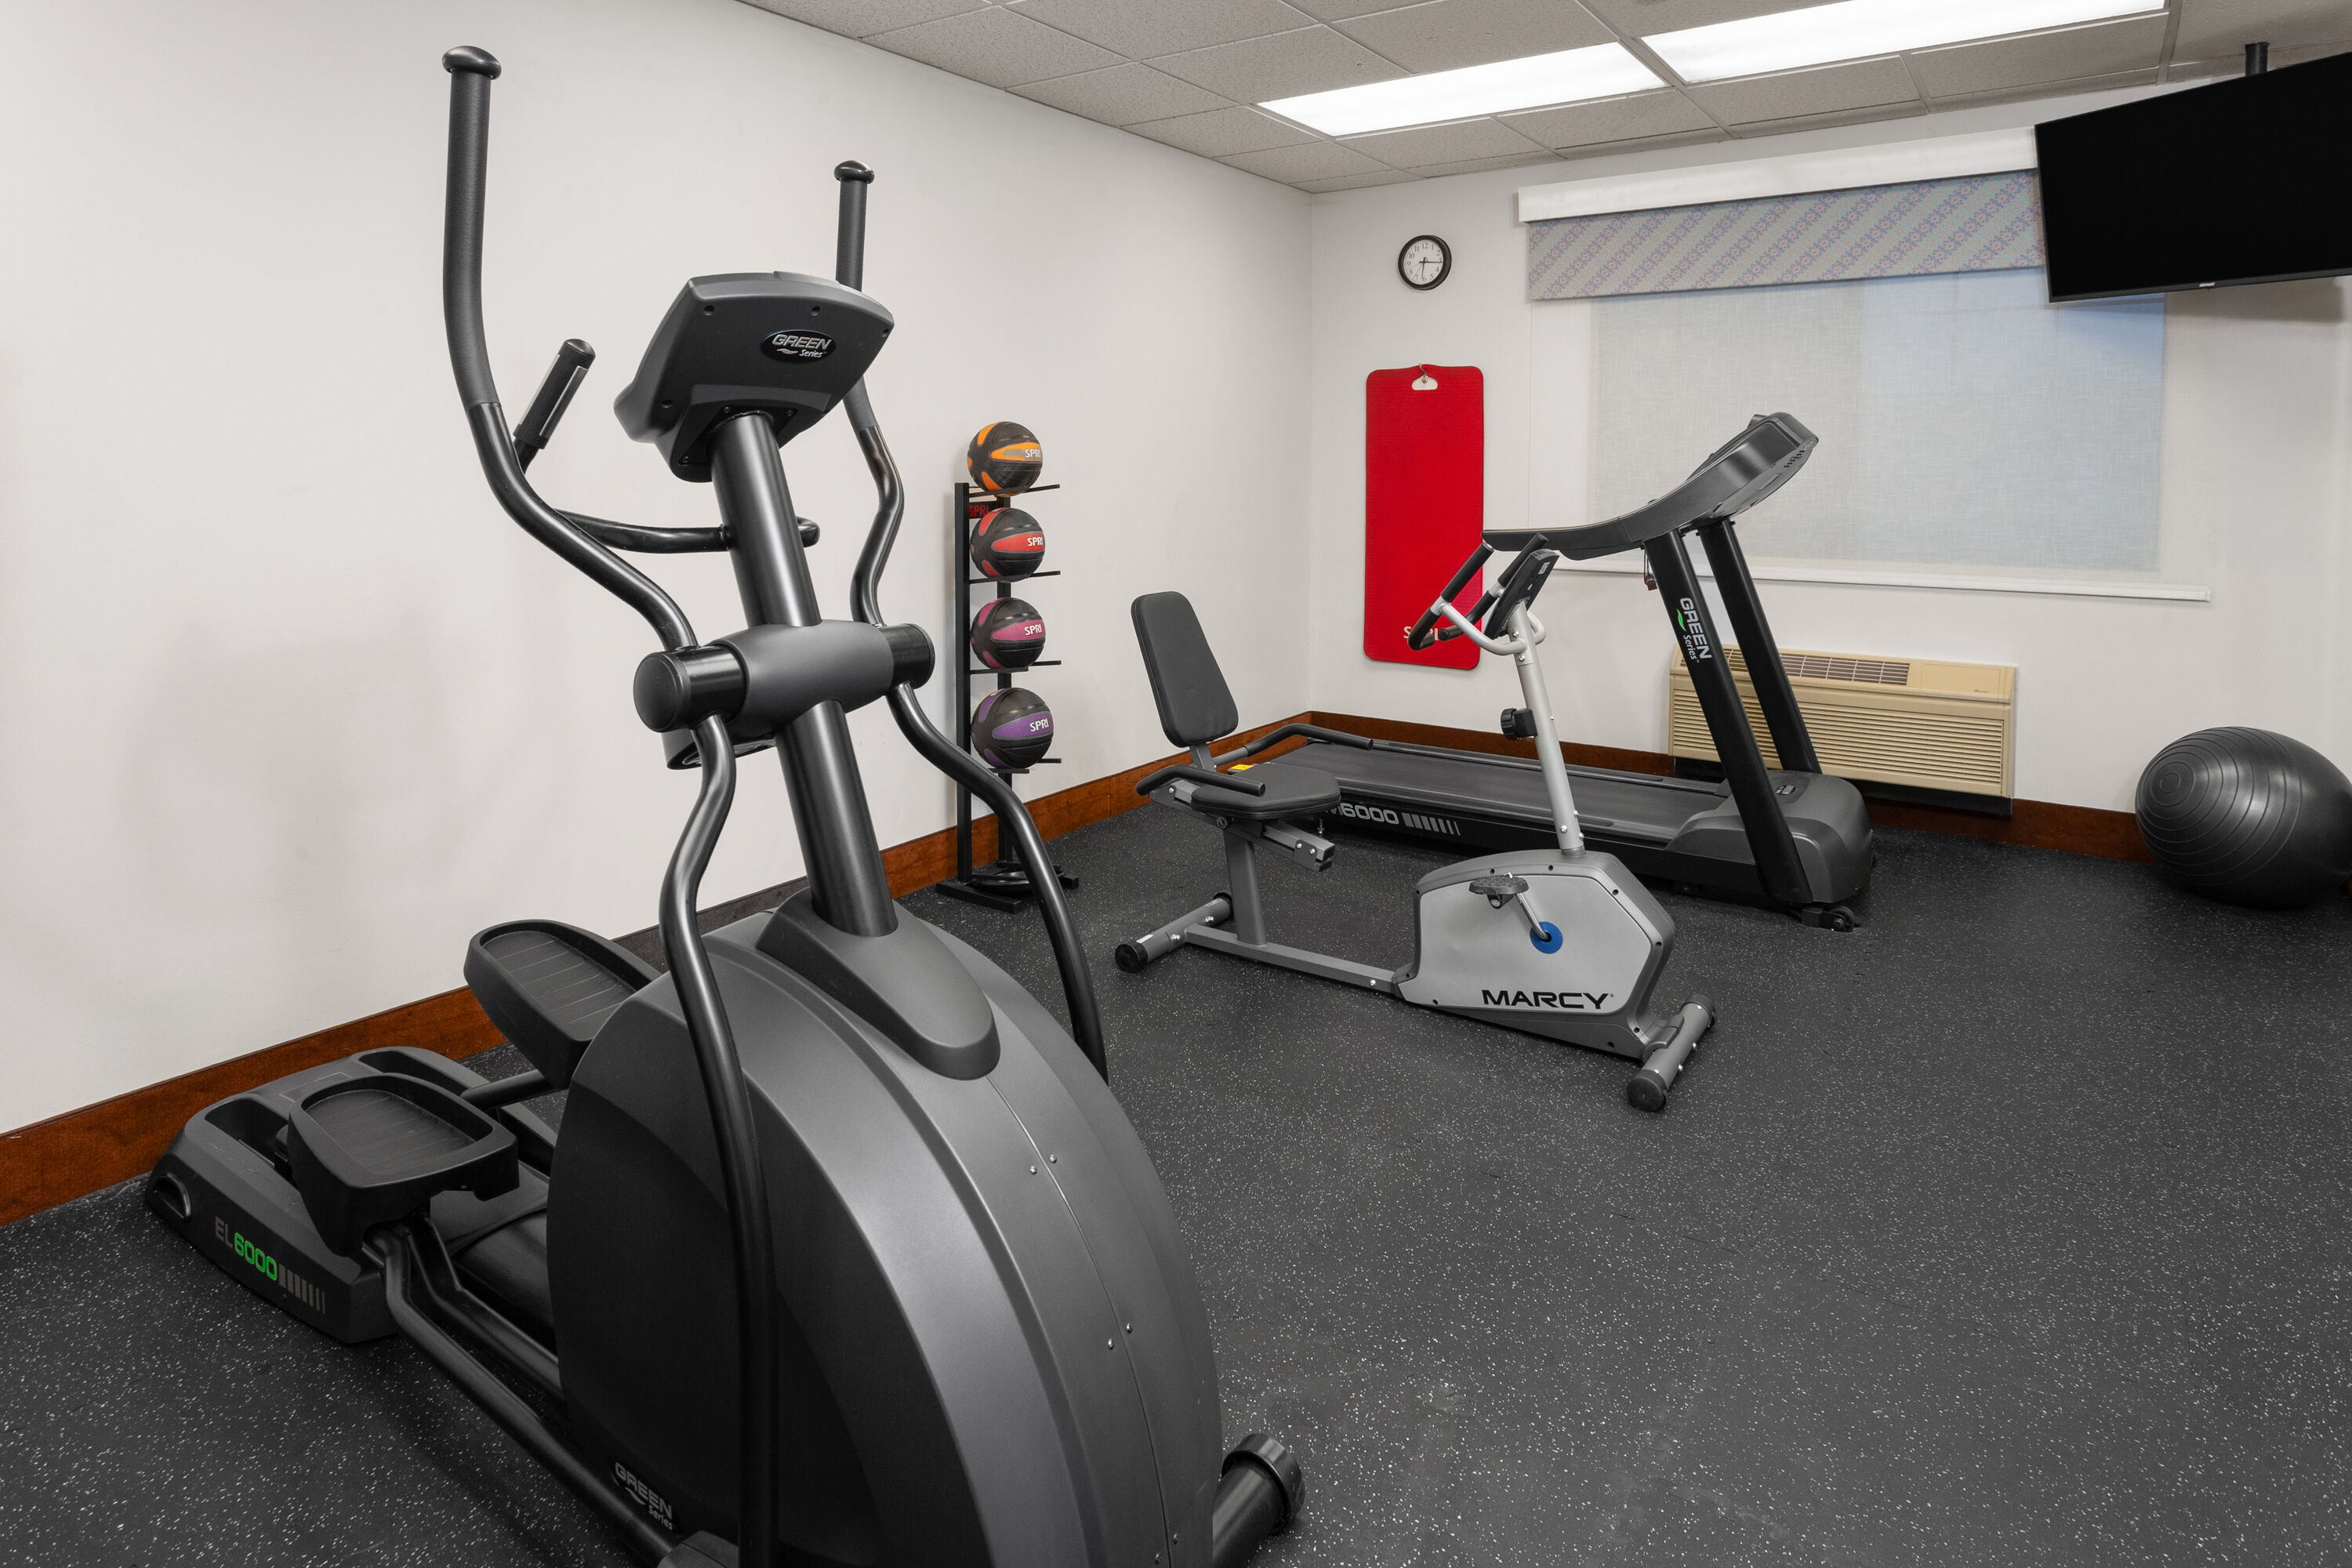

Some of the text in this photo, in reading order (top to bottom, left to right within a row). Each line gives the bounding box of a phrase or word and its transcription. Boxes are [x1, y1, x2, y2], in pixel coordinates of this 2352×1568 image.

[772, 334, 832, 350] GREEN
[799, 349, 824, 358] Series
[968, 504, 989, 517] SPRI
[1027, 536, 1044, 546] SPRI
[1024, 623, 1042, 636] SPRI
[1403, 626, 1439, 641] SI
[1680, 597, 1712, 659] GREEN
[1683, 634, 1697, 660] Series
[1029, 717, 1049, 732] SPRI
[1482, 989, 1609, 1009] MARCY
[615, 1462, 672, 1519] GREEN
[648, 1504, 673, 1530] Series
